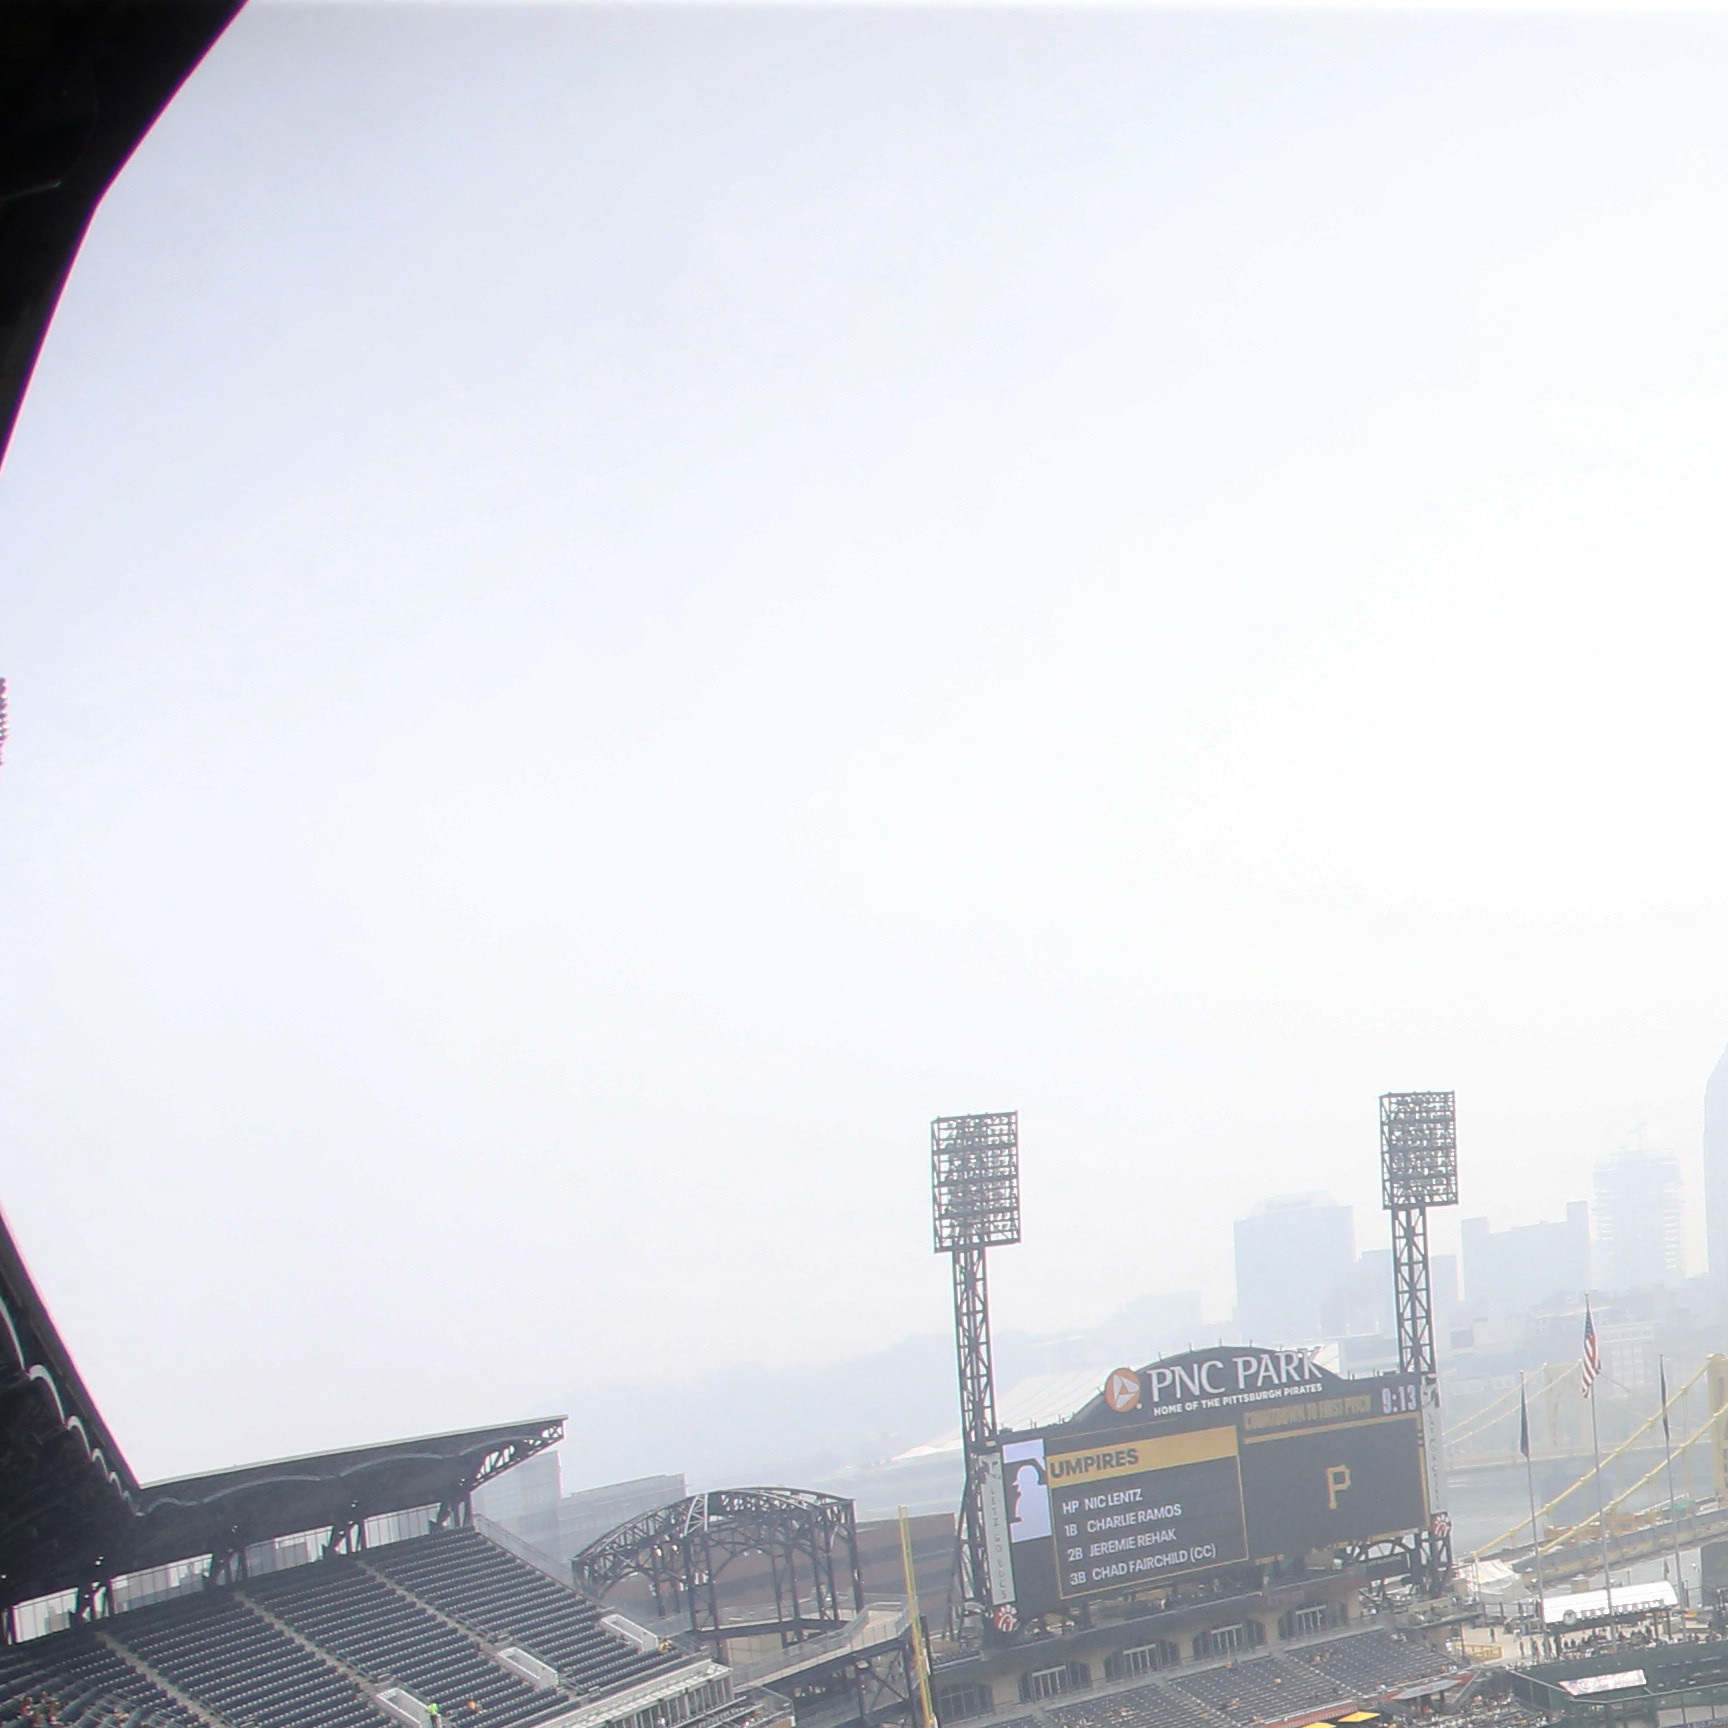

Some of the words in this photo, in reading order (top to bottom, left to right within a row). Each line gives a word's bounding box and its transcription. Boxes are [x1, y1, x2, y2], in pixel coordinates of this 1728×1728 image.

[1147, 1364, 1225, 1402] PNC
[1232, 1346, 1323, 1389] PARK
[1153, 1403, 1181, 1416] HOME
[1183, 1401, 1198, 1413] OF
[1200, 1398, 1220, 1411] THE
[1223, 1389, 1282, 1408] PITTSBURGH
[1283, 1383, 1324, 1399] PIRATES
[1382, 1385, 1417, 1414] 9:13
[1050, 1448, 1140, 1479] UMPIRES
[1062, 1500, 1080, 1514] HP
[1084, 1495, 1105, 1510] NIC
[1106, 1488, 1143, 1507] LENTZ
[1325, 1463, 1352, 1510] P
[1064, 1523, 1079, 1537] 1B
[1086, 1512, 1135, 1533] CHARLIE
[1137, 1503, 1182, 1525] RAMOS
[1067, 1547, 1084, 1561] 2B
[1089, 1537, 1135, 1558] JEREMIE
[1137, 1527, 1177, 1548] REHAK
[1069, 1571, 1087, 1586] 3B
[1092, 1563, 1128, 1583] CHAD
[1129, 1550, 1188, 1573] FAIRCHILD
[1190, 1543, 1217, 1563] (CC)
